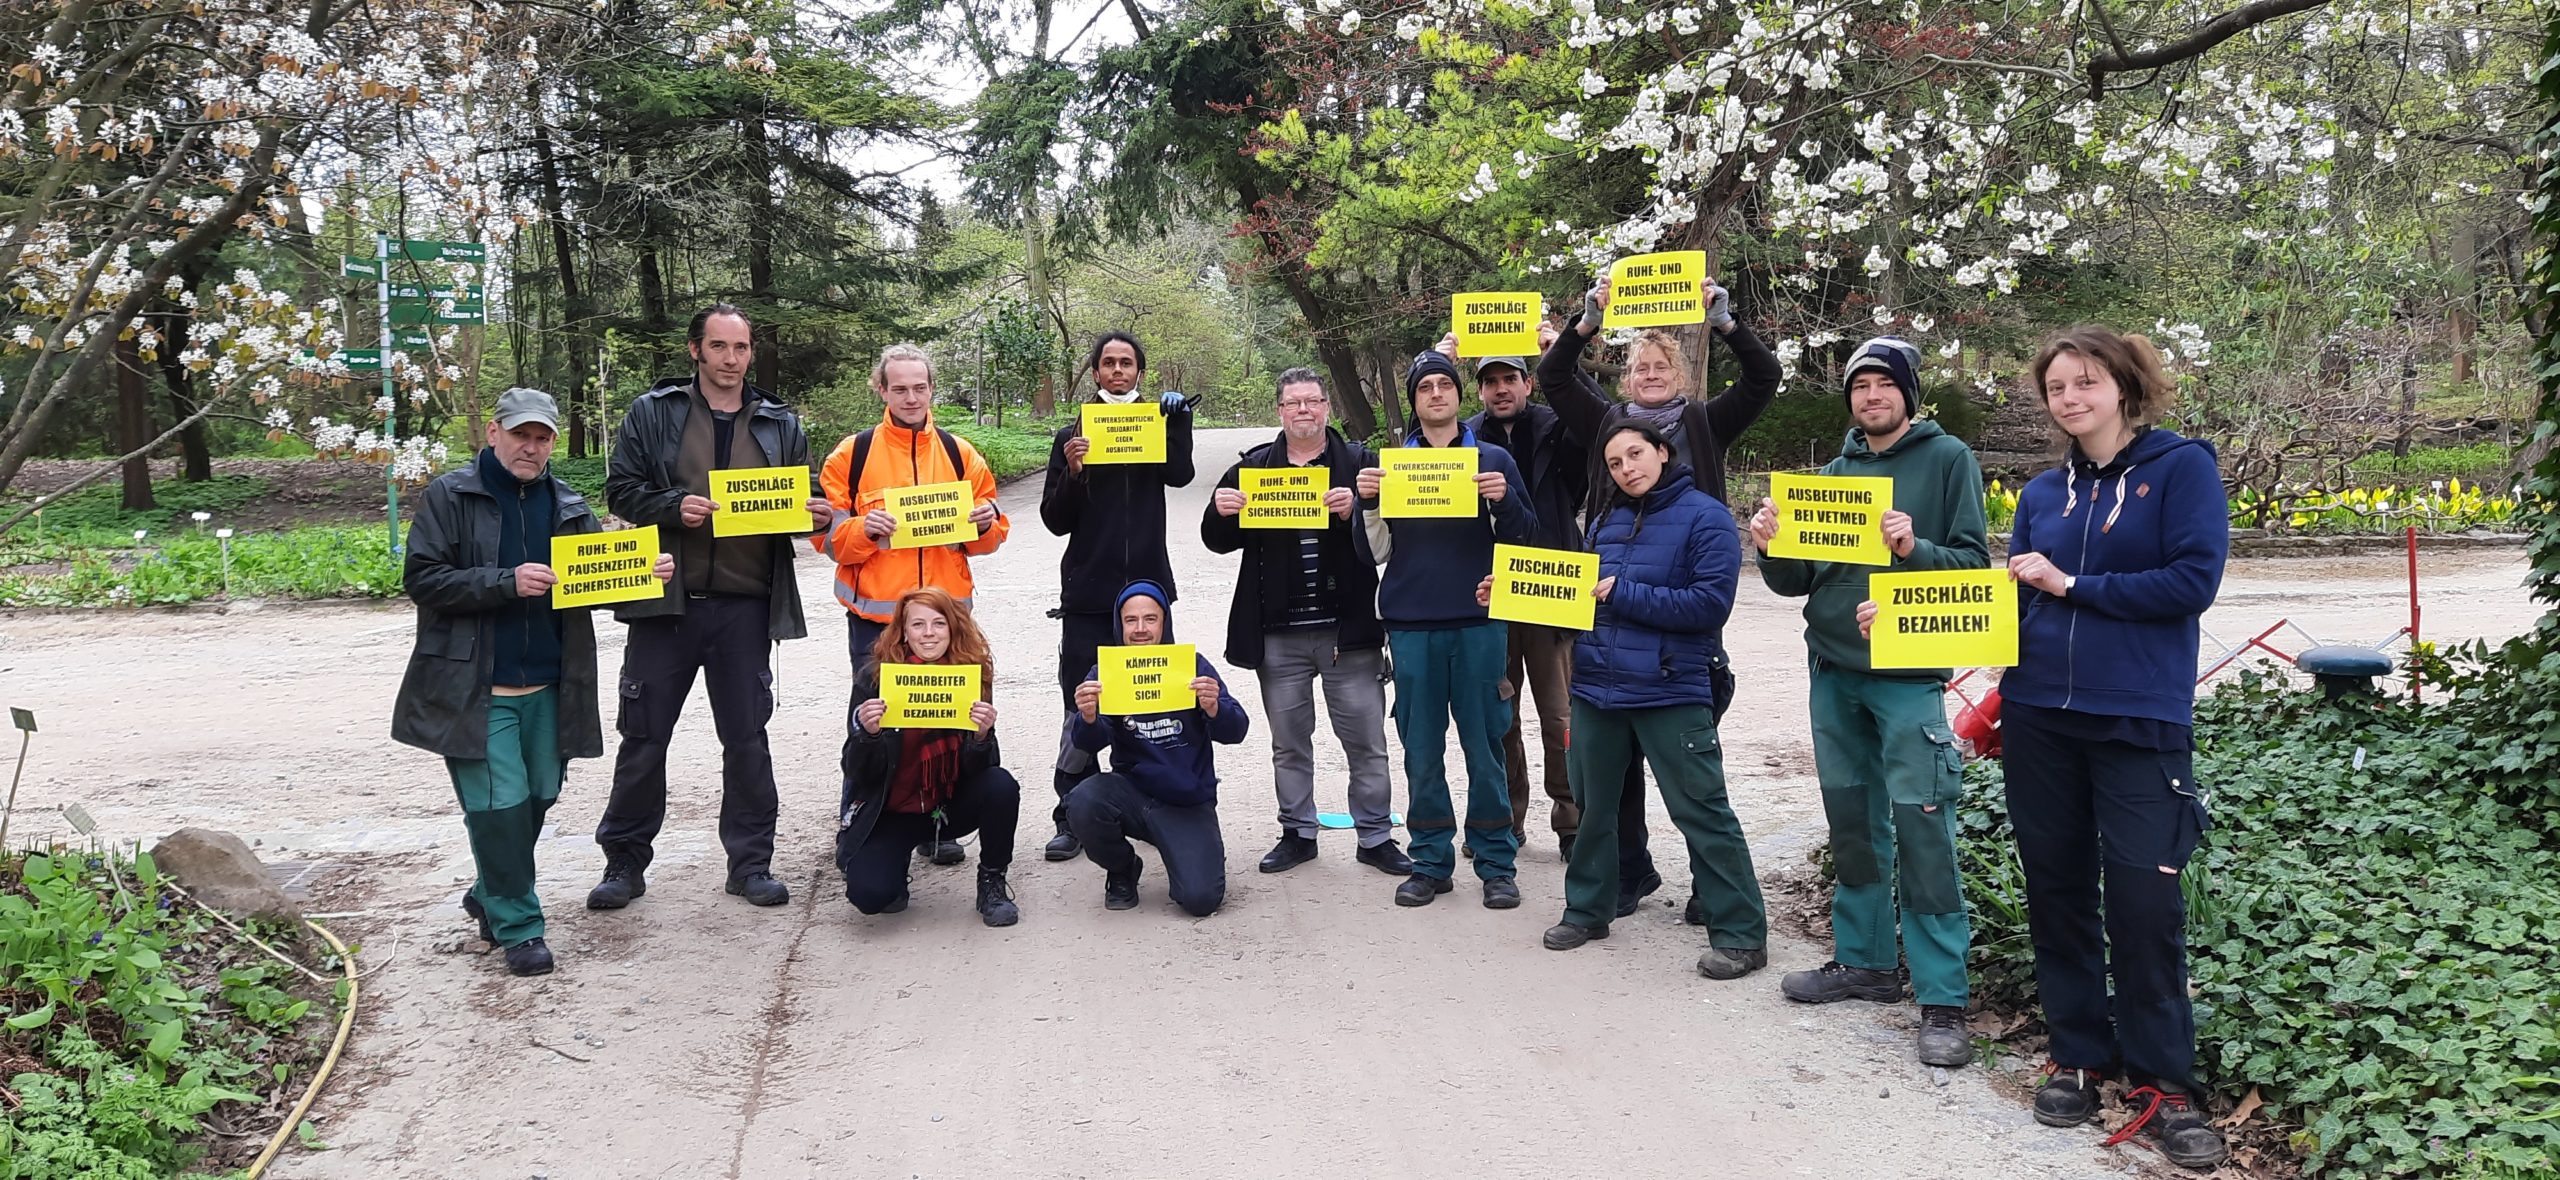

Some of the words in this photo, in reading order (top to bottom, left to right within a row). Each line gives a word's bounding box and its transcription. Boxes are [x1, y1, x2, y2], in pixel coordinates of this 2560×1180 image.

[1626, 264, 1658, 278] RUHE-
[1659, 262, 1682, 276] UND
[1618, 280, 1692, 298] PAUSENZEITEN
[1465, 302, 1527, 315] ZUSCHLÄGE
[1613, 299, 1696, 316] SICHERSTELLEN!
[1468, 321, 1525, 334] BEZAHLEN!
[1094, 416, 1154, 424] GEWERKSCHAFTLICHE
[1106, 425, 1142, 433] SOLIDARITÄT
[1393, 462, 1465, 471] GEWERKSCHAFTLICHE
[1259, 477, 1288, 487] RUHE-
[1289, 476, 1309, 486] UND
[1407, 473, 1450, 482] SOLIDARITÄT
[726, 477, 795, 494] ZUSCHLÄGE
[1418, 486, 1440, 494] GEGEN
[899, 491, 959, 507] AUSBEUTUNG
[1251, 491, 1317, 502] PAUSENZEITEN
[1406, 497, 1451, 506] AUSBEUTUNG
[1787, 487, 1872, 505] AUSBEUTUNG
[730, 497, 793, 514] BEZAHLEN!
[1247, 507, 1321, 518] SICHERSTELLEN!
[905, 511, 920, 522] BEI
[921, 507, 957, 520] VETMED
[1794, 508, 1814, 522] BEI
[1816, 510, 1867, 526] VETMED
[912, 523, 955, 537] BEENDEN!
[1799, 530, 1860, 548] BEENDEN!
[577, 542, 612, 557] RUHE-
[614, 540, 637, 553] UND
[567, 556, 647, 577] PAUSENZEITEN
[1508, 558, 1582, 579] ZUSCHLÄGE
[562, 573, 652, 596] SICHERSTELLEN!
[1511, 580, 1577, 601] BEZAHLEN!
[1892, 585, 1993, 605] ZUSCHLÄGE
[1898, 614, 1990, 634] BEZAHLEN!
[1125, 657, 1168, 669] KÄMPFEN
[895, 675, 966, 687] VORARBEITER
[1133, 673, 1162, 685] LOHNT
[908, 692, 952, 704] ZULAGEN
[1135, 689, 1161, 701] SICH!
[903, 709, 957, 719] BEZAHLEN!
